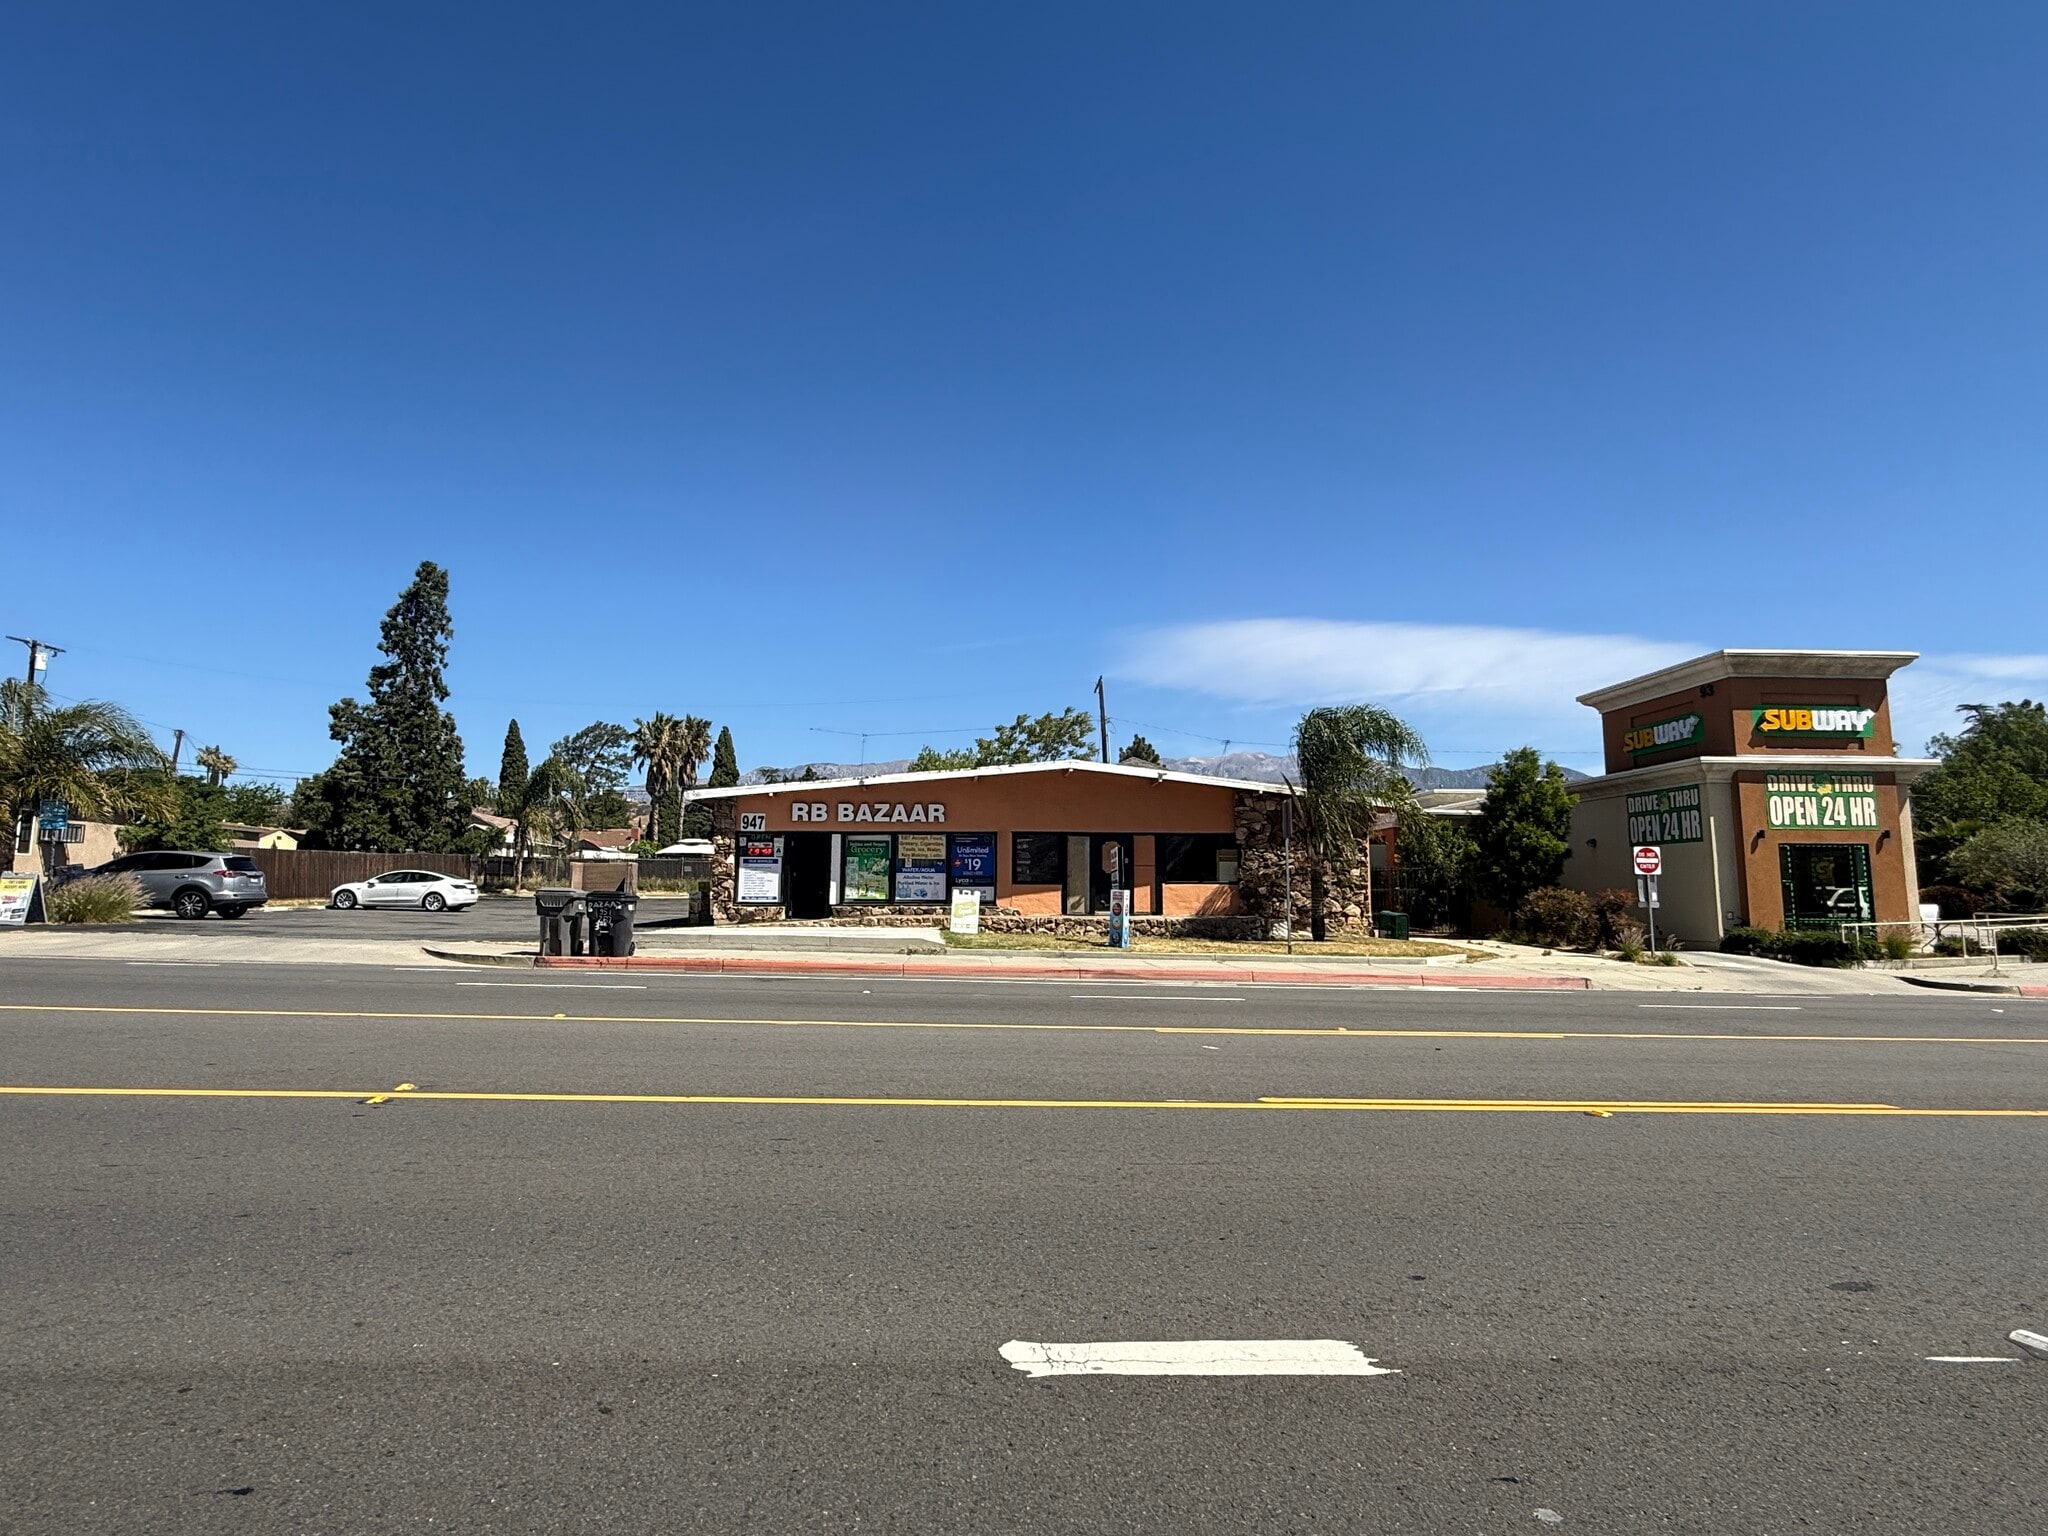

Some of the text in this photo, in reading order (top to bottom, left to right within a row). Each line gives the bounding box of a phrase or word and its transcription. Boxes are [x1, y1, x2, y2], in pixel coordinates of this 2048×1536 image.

[1759, 708, 1876, 732] SUBWAY
[1622, 714, 1700, 753] SUBWAY
[1766, 774, 1874, 793] DRIVE THRU
[1627, 788, 1699, 814] DRIVE THRU
[1769, 795, 1877, 826] OPEN 24 HR
[742, 815, 765, 830] 947
[791, 803, 945, 823] RB BAZAAR
[1629, 809, 1701, 844] OPEN 24 HR
[850, 846, 885, 855] Grocery
[956, 846, 989, 854] Unlimited
[964, 858, 982, 871] $19
